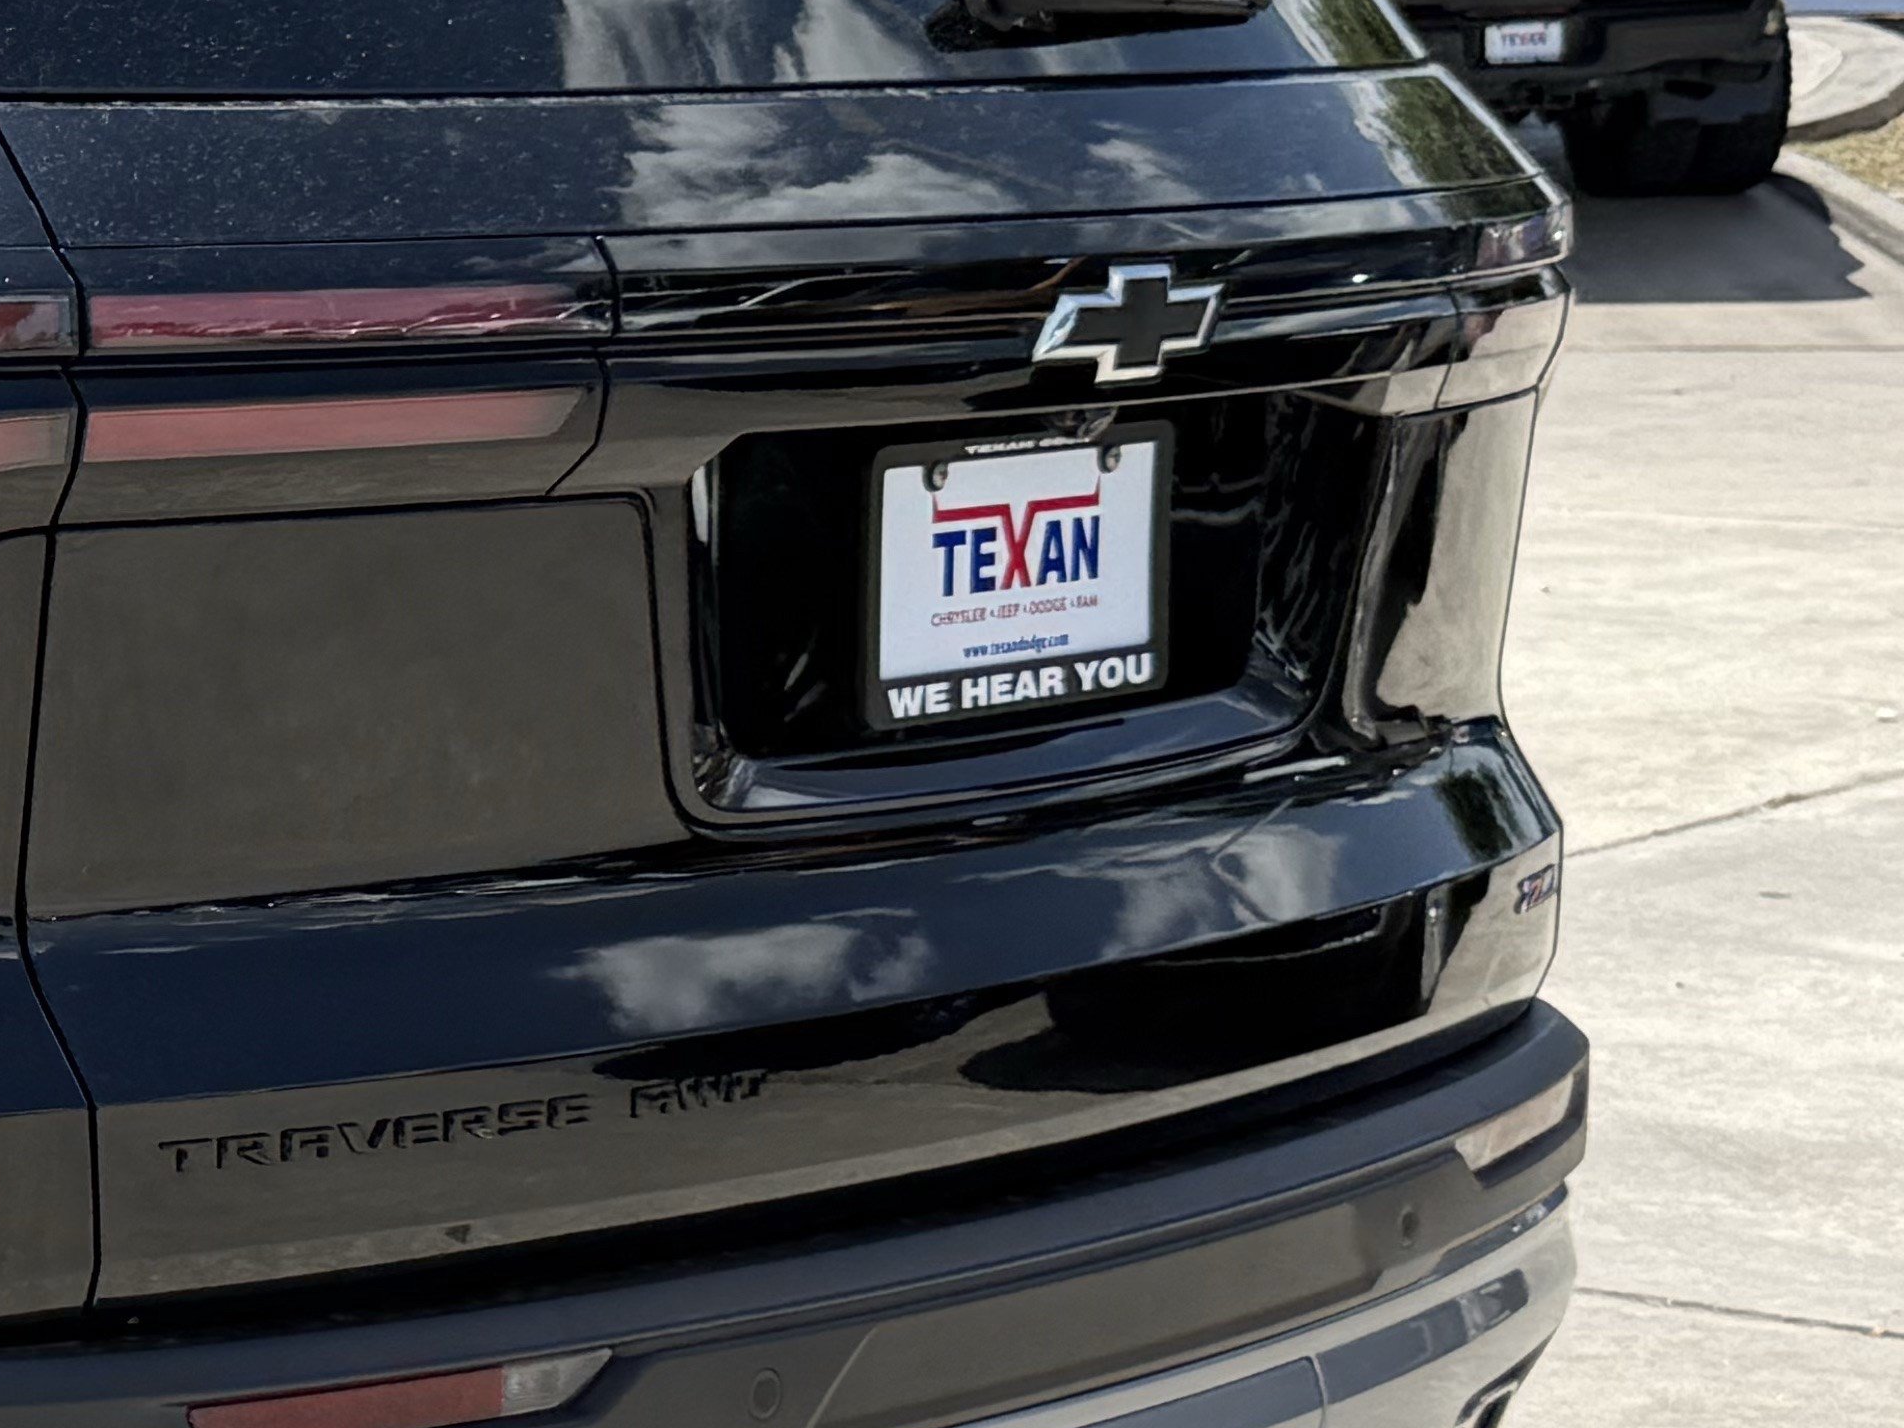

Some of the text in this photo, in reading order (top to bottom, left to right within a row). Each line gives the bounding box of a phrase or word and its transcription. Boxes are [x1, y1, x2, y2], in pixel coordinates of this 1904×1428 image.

[932, 492, 1101, 597] TEXAN
[887, 652, 1153, 720] WE HEAR YOU
[157, 1091, 594, 1174] TRAVERSE
